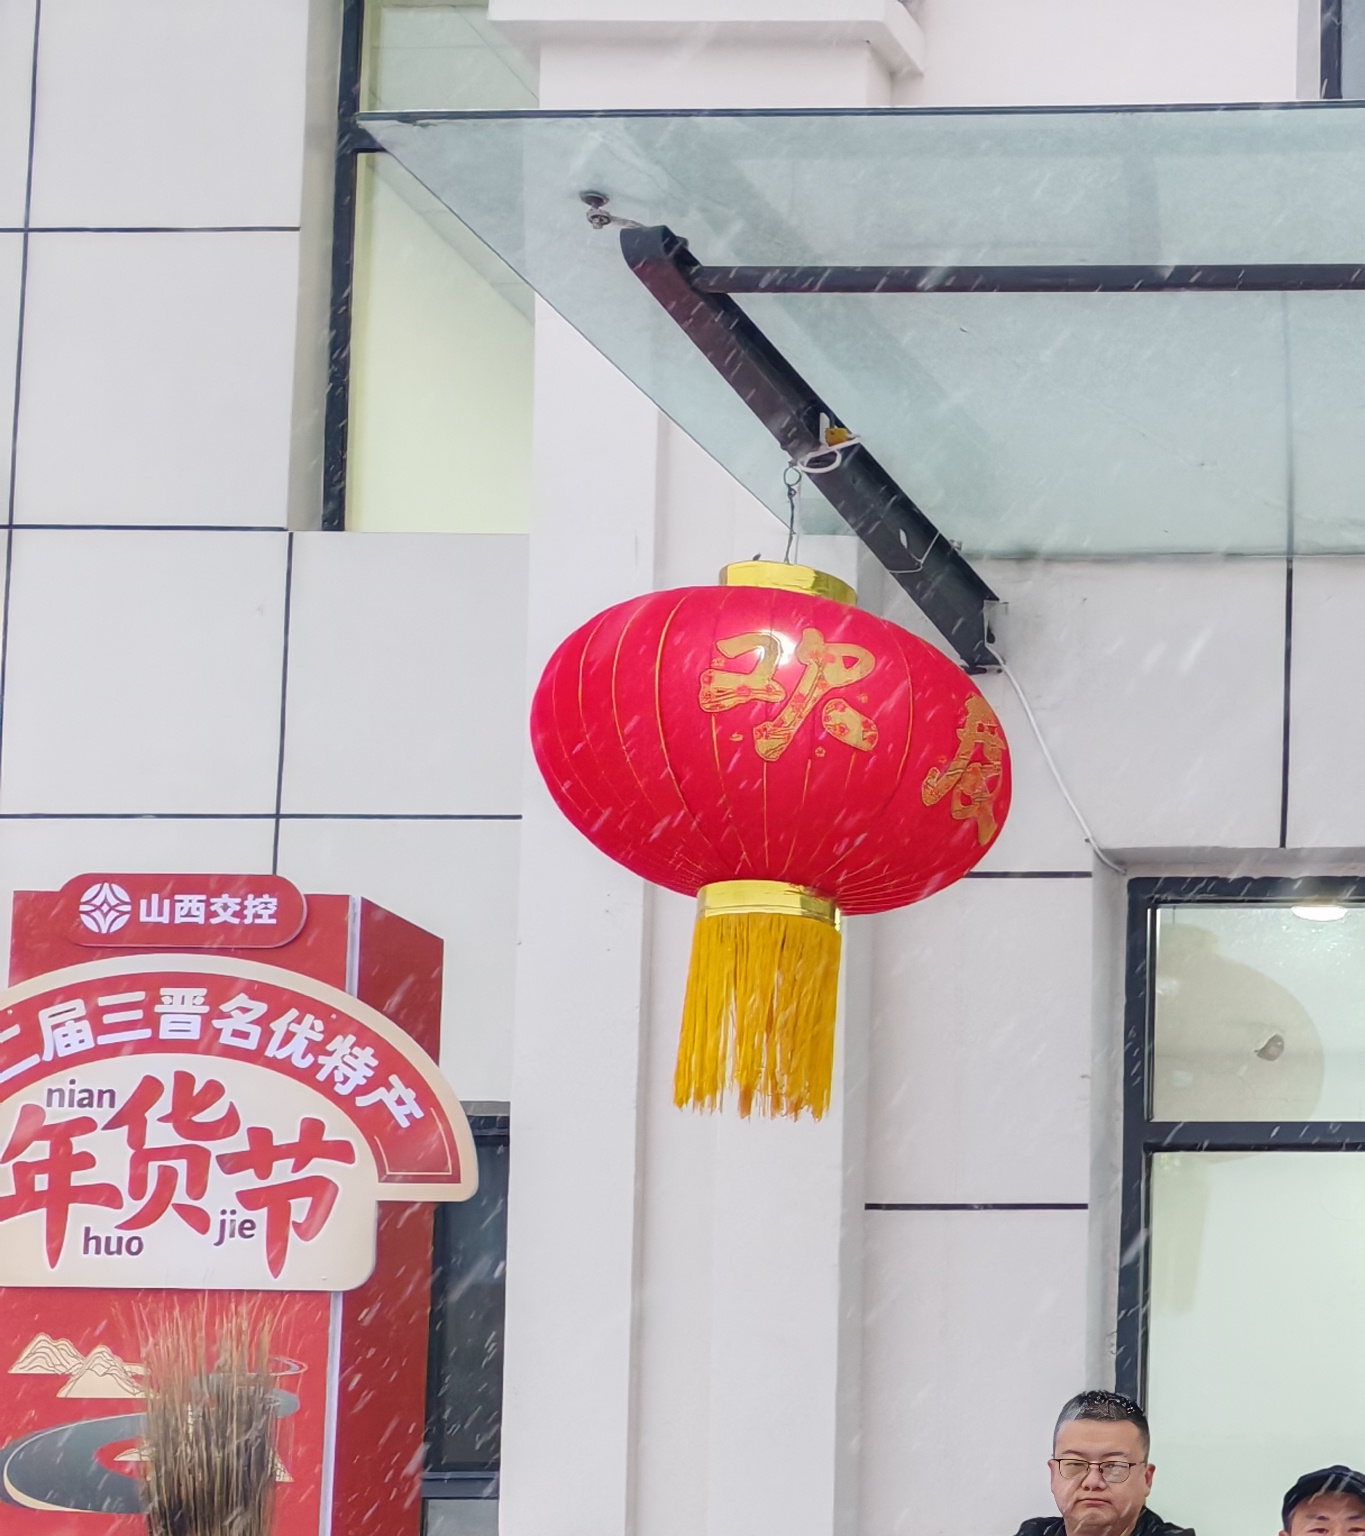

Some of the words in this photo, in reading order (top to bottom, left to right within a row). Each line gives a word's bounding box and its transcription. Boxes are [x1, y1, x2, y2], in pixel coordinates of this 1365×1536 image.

[138, 893, 278, 925] 山西交控
[46, 1078, 117, 1109] nian
[0, 1070, 356, 1279] 年货节
[82, 1227, 145, 1256] huo
[213, 1208, 257, 1246] jie
